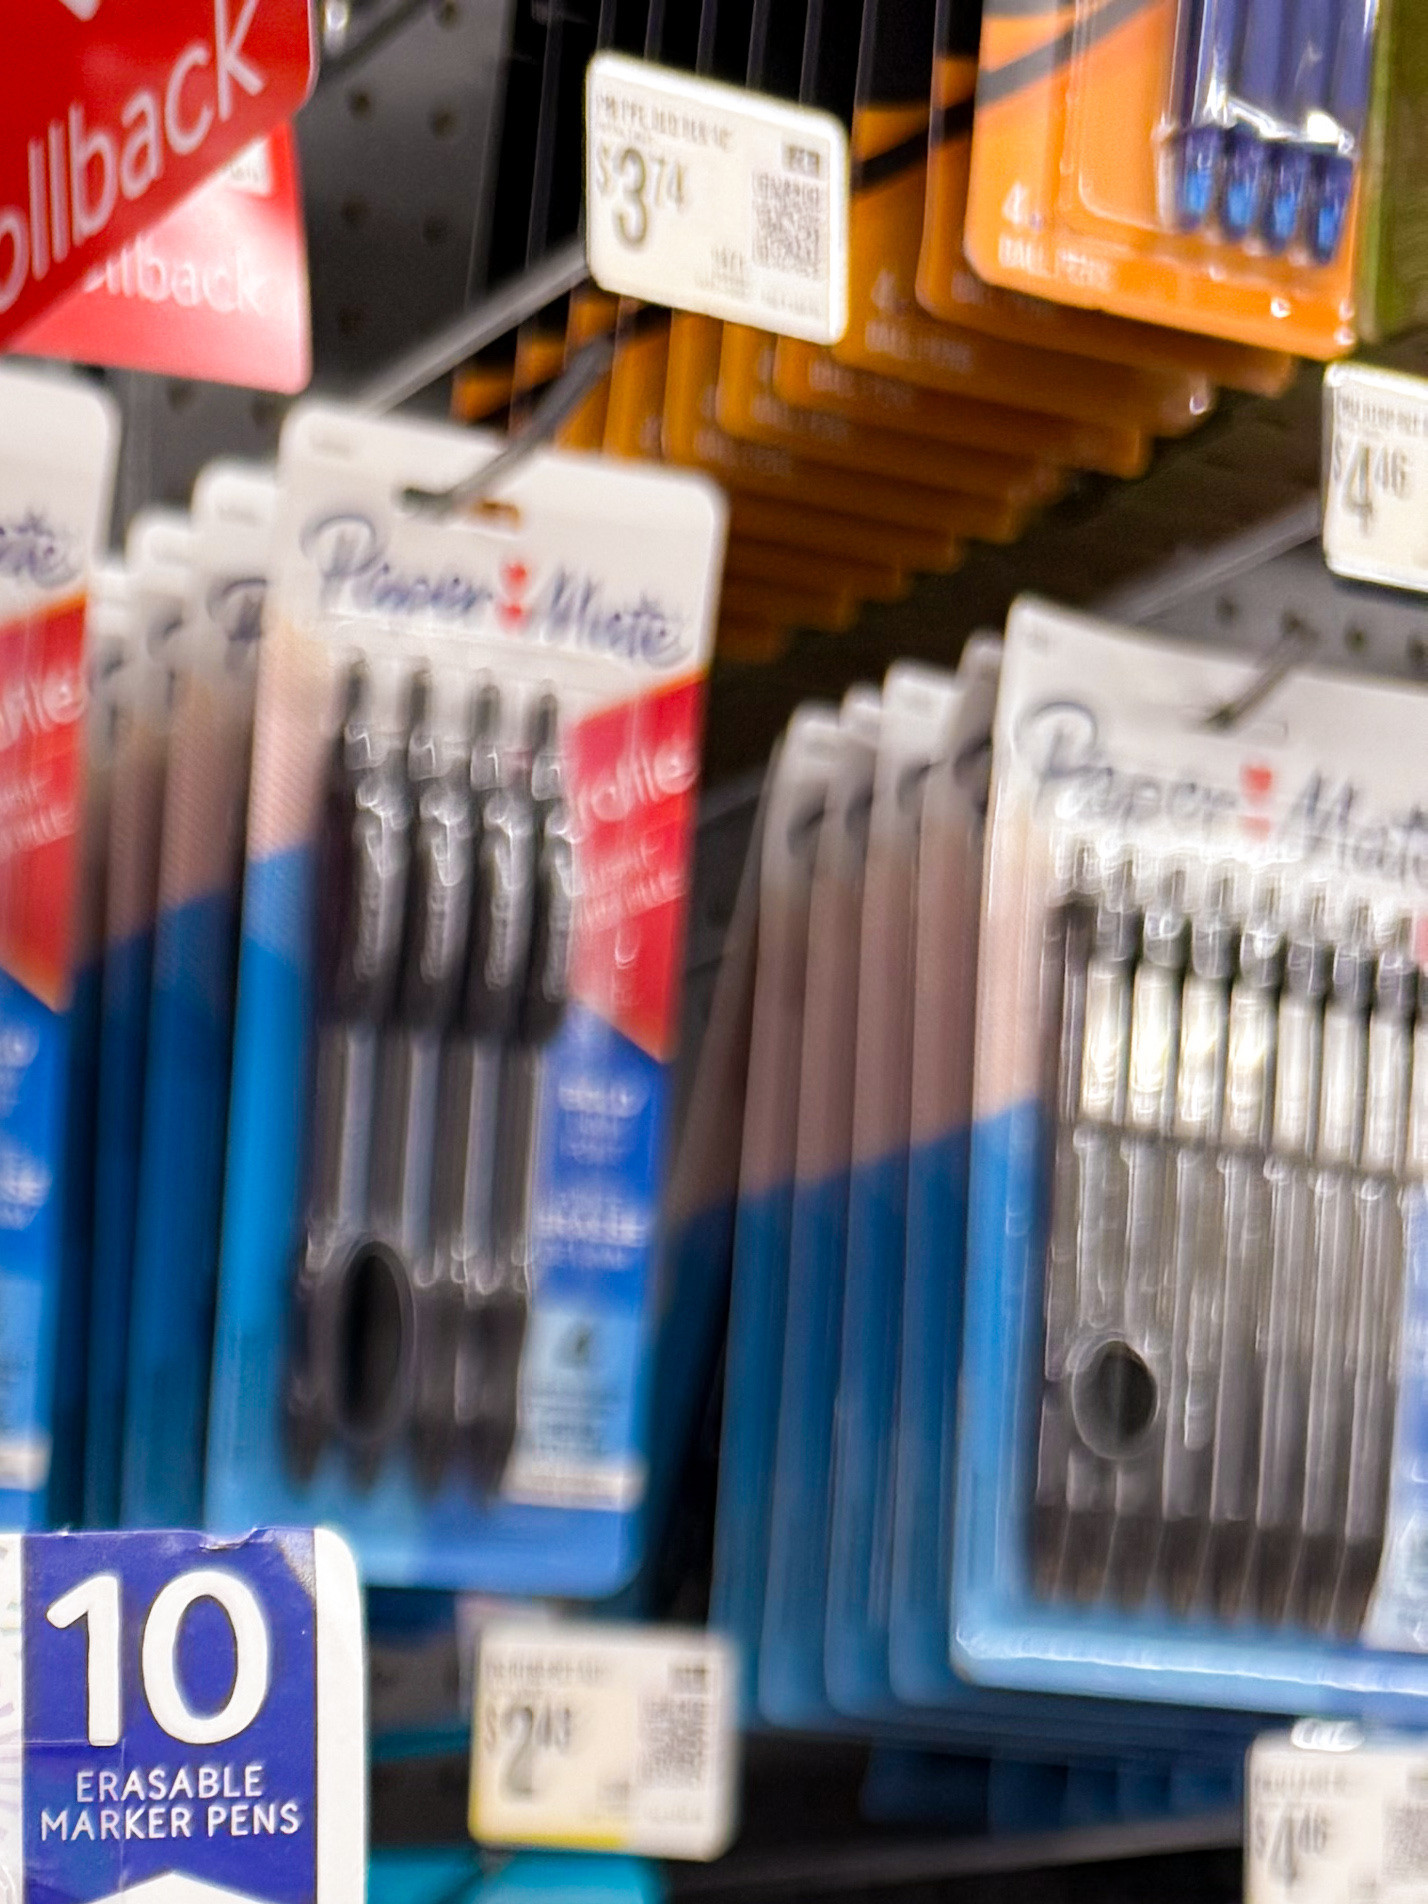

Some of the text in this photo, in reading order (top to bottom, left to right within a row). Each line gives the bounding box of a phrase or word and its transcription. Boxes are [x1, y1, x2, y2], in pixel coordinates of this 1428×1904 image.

[46, 1570, 271, 1747] 10
[77, 1765, 263, 1803] ERASABLE
[40, 1802, 301, 1842] MARKER PENS
